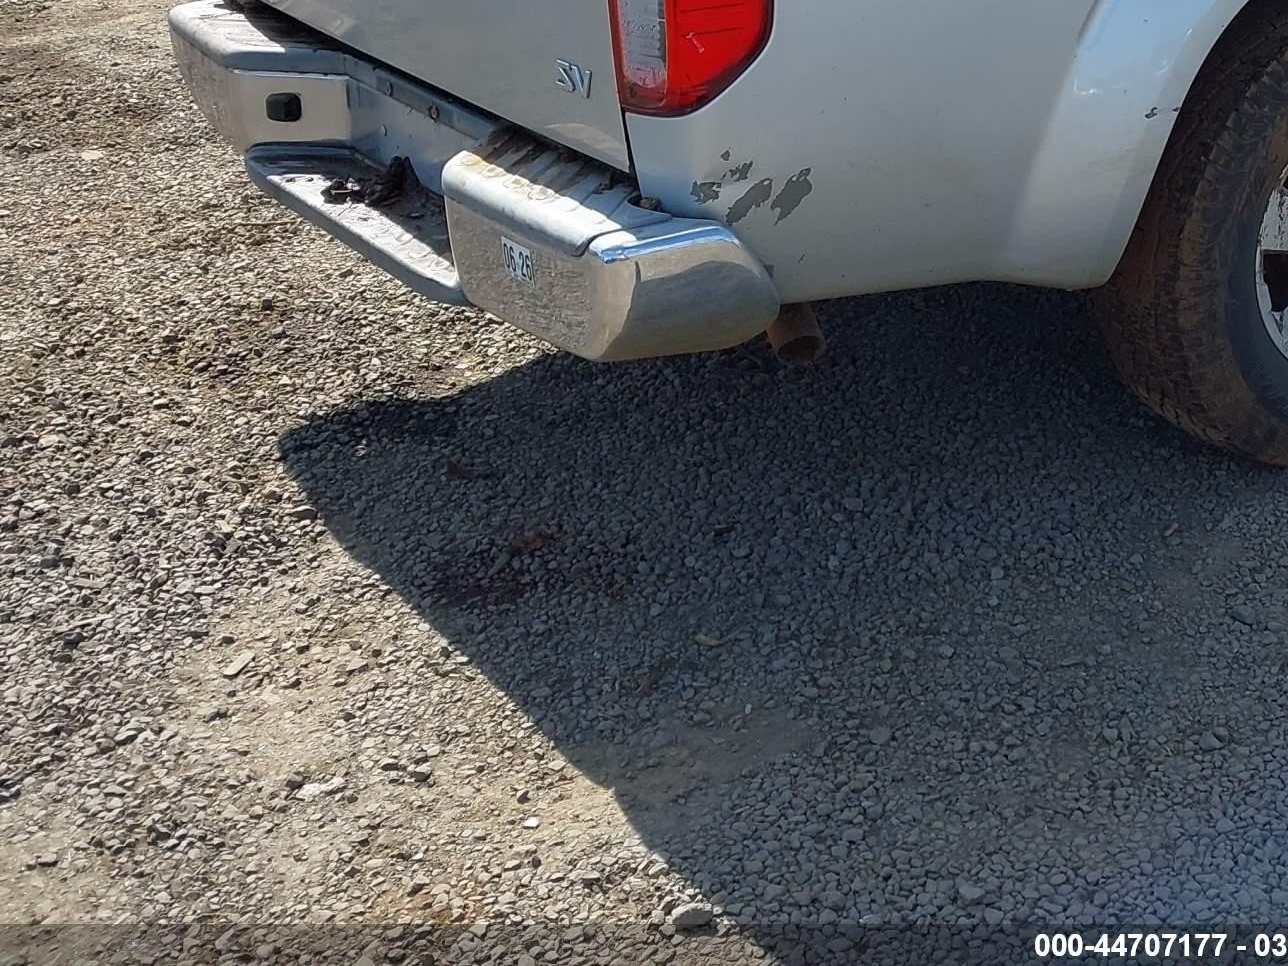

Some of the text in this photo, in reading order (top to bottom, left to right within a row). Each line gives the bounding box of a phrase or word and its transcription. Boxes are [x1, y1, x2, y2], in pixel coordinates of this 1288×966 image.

[555, 58, 592, 99] SV
[503, 242, 532, 281] 06 26
